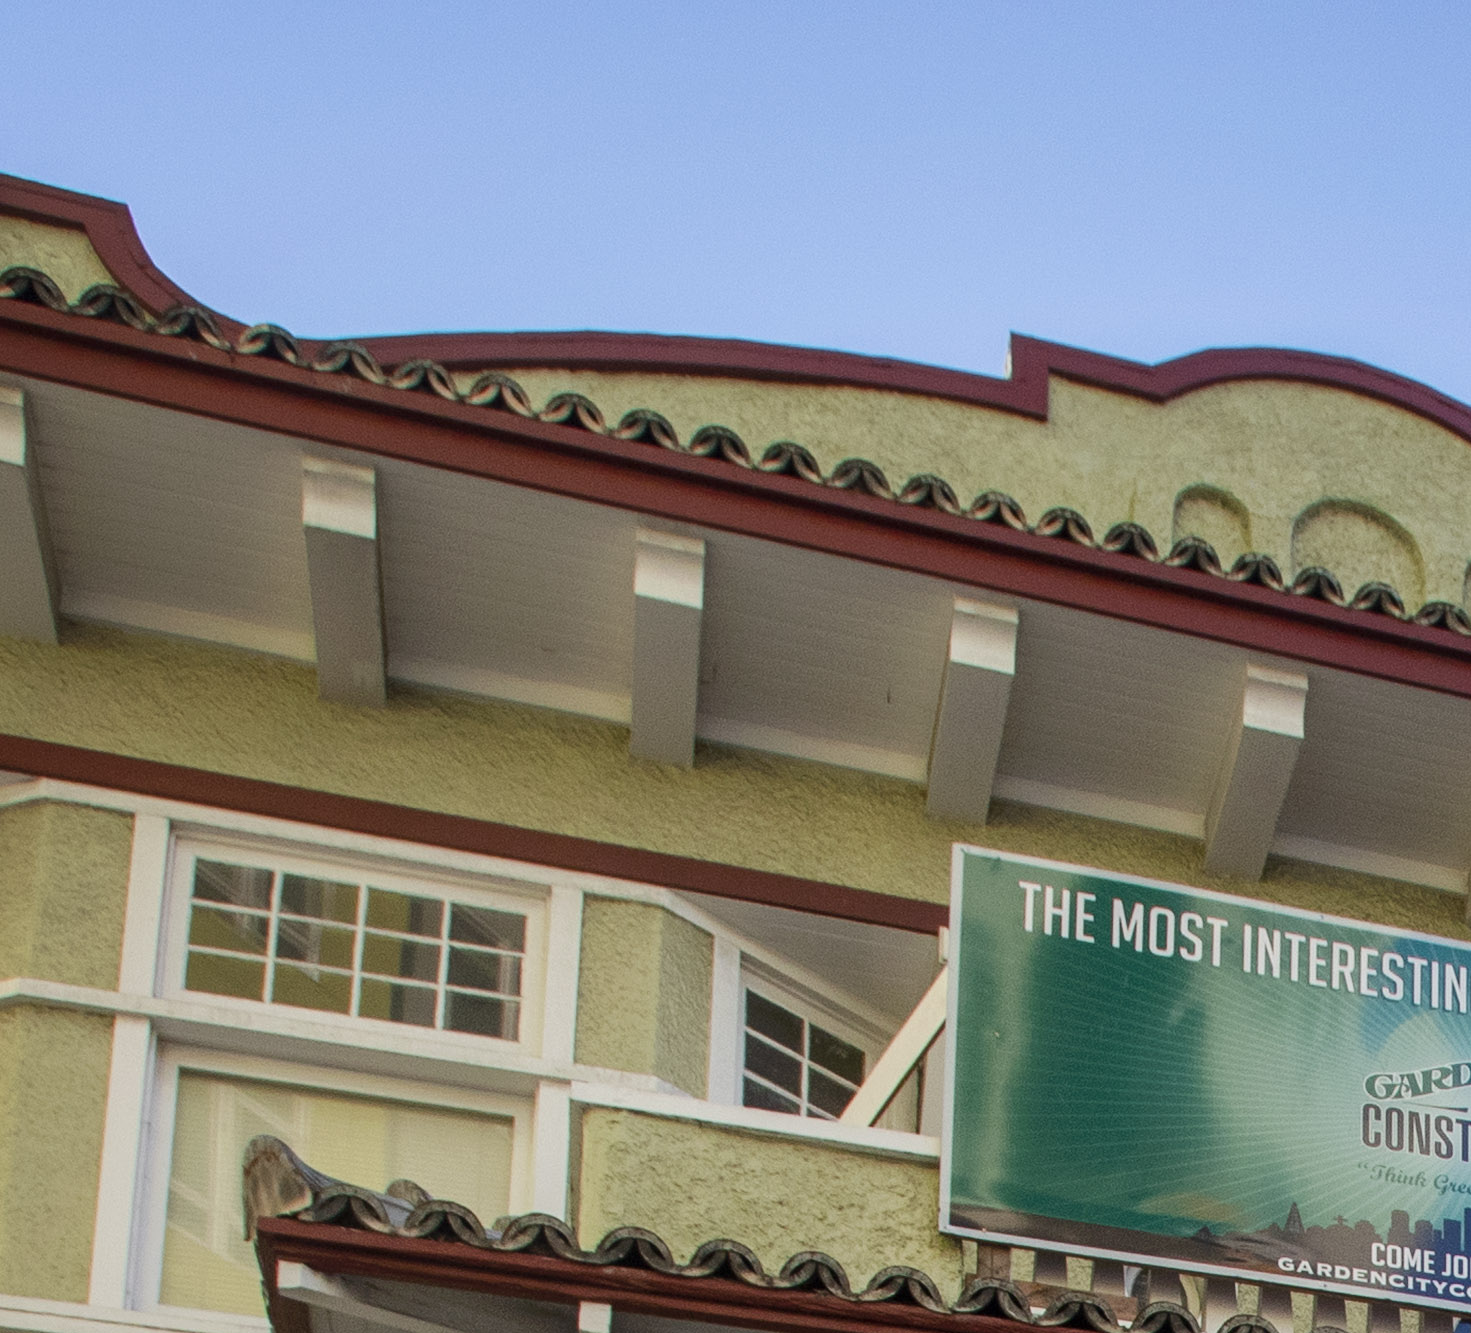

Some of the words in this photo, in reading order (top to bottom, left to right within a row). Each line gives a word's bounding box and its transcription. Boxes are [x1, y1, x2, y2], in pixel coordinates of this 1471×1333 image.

[1019, 880, 1096, 943] THE
[1111, 897, 1229, 968] MOST
[1370, 1242, 1435, 1274] COME
